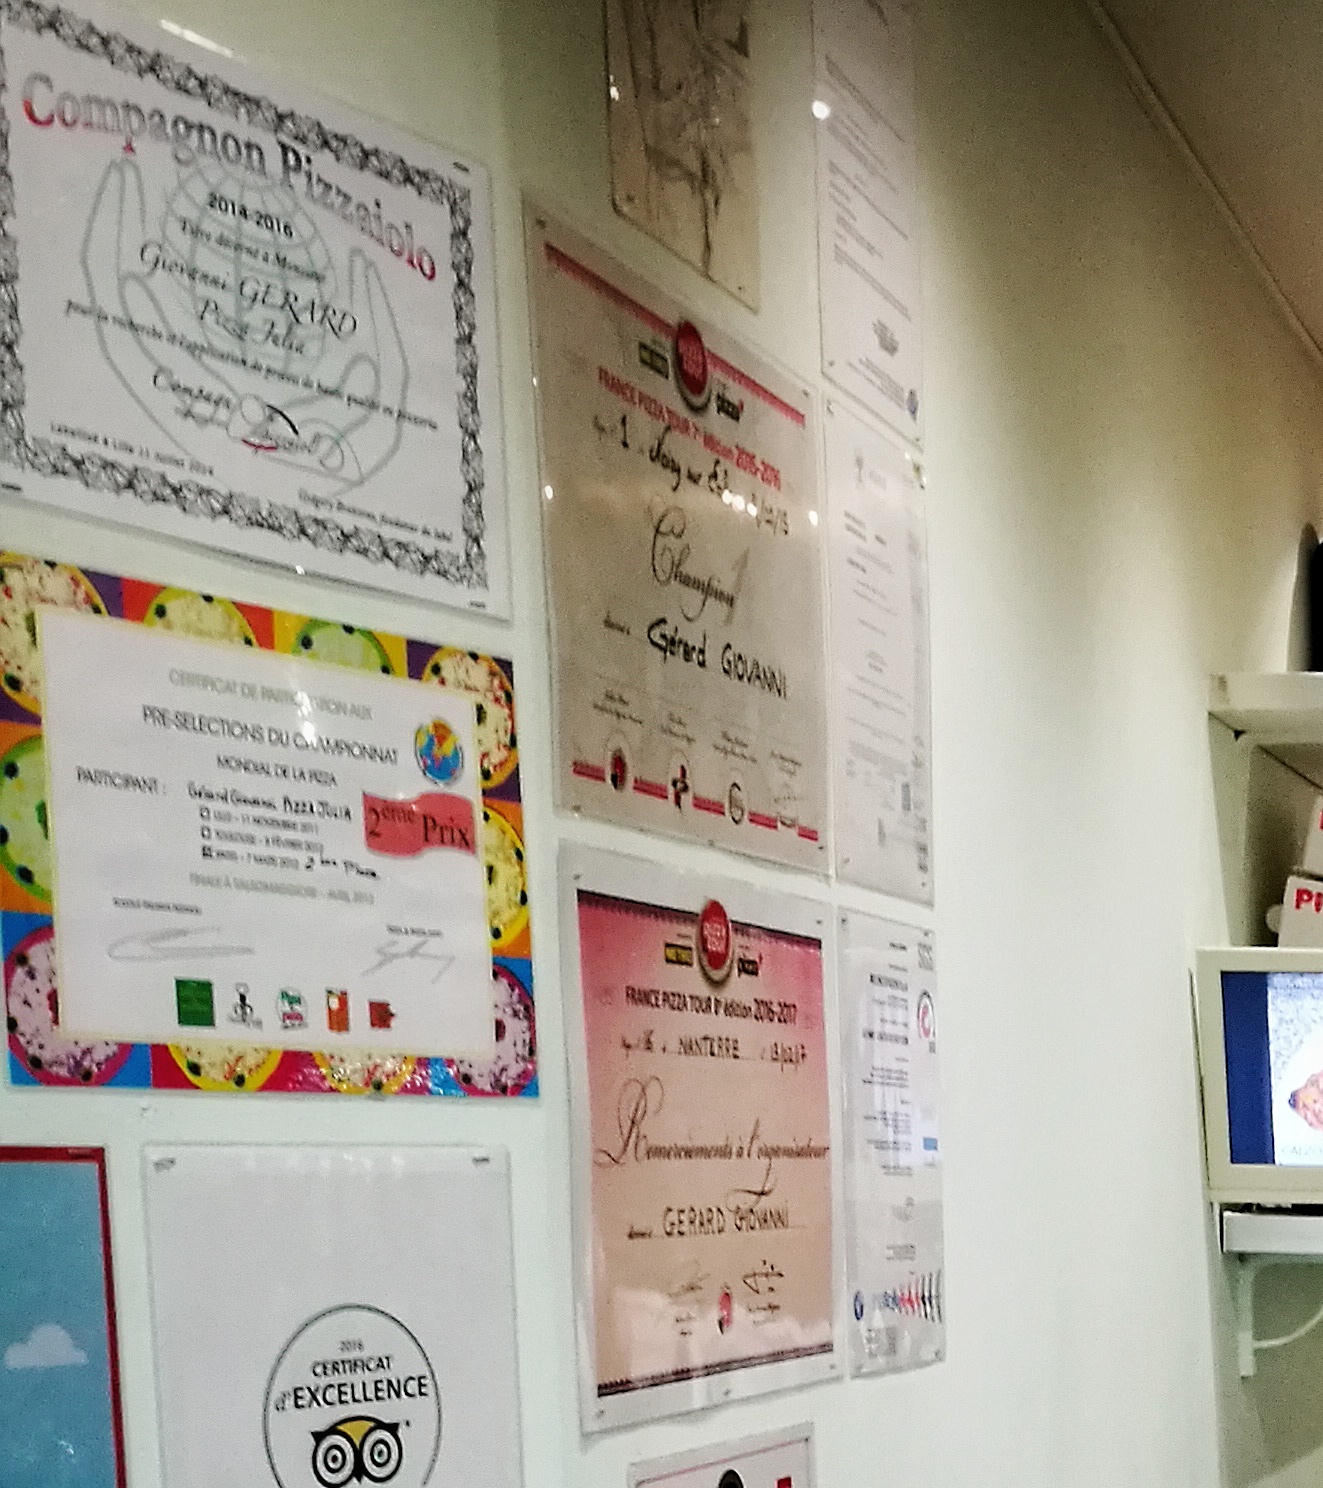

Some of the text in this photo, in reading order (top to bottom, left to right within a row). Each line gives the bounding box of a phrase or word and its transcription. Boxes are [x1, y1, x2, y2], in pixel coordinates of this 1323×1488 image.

[21, 72, 437, 282] Compagnon Pizzaiolo
[208, 191, 294, 238] 2014-2016
[239, 274, 357, 340] GERARD
[647, 616, 787, 699] Gérard GIOVANNI
[268, 726, 289, 747] DU
[422, 808, 472, 848] Prix
[663, 1206, 726, 1237] GERARD
[311, 1355, 392, 1378] CERTIFICAT
[275, 1374, 429, 1412] d'EXCELLENCE
